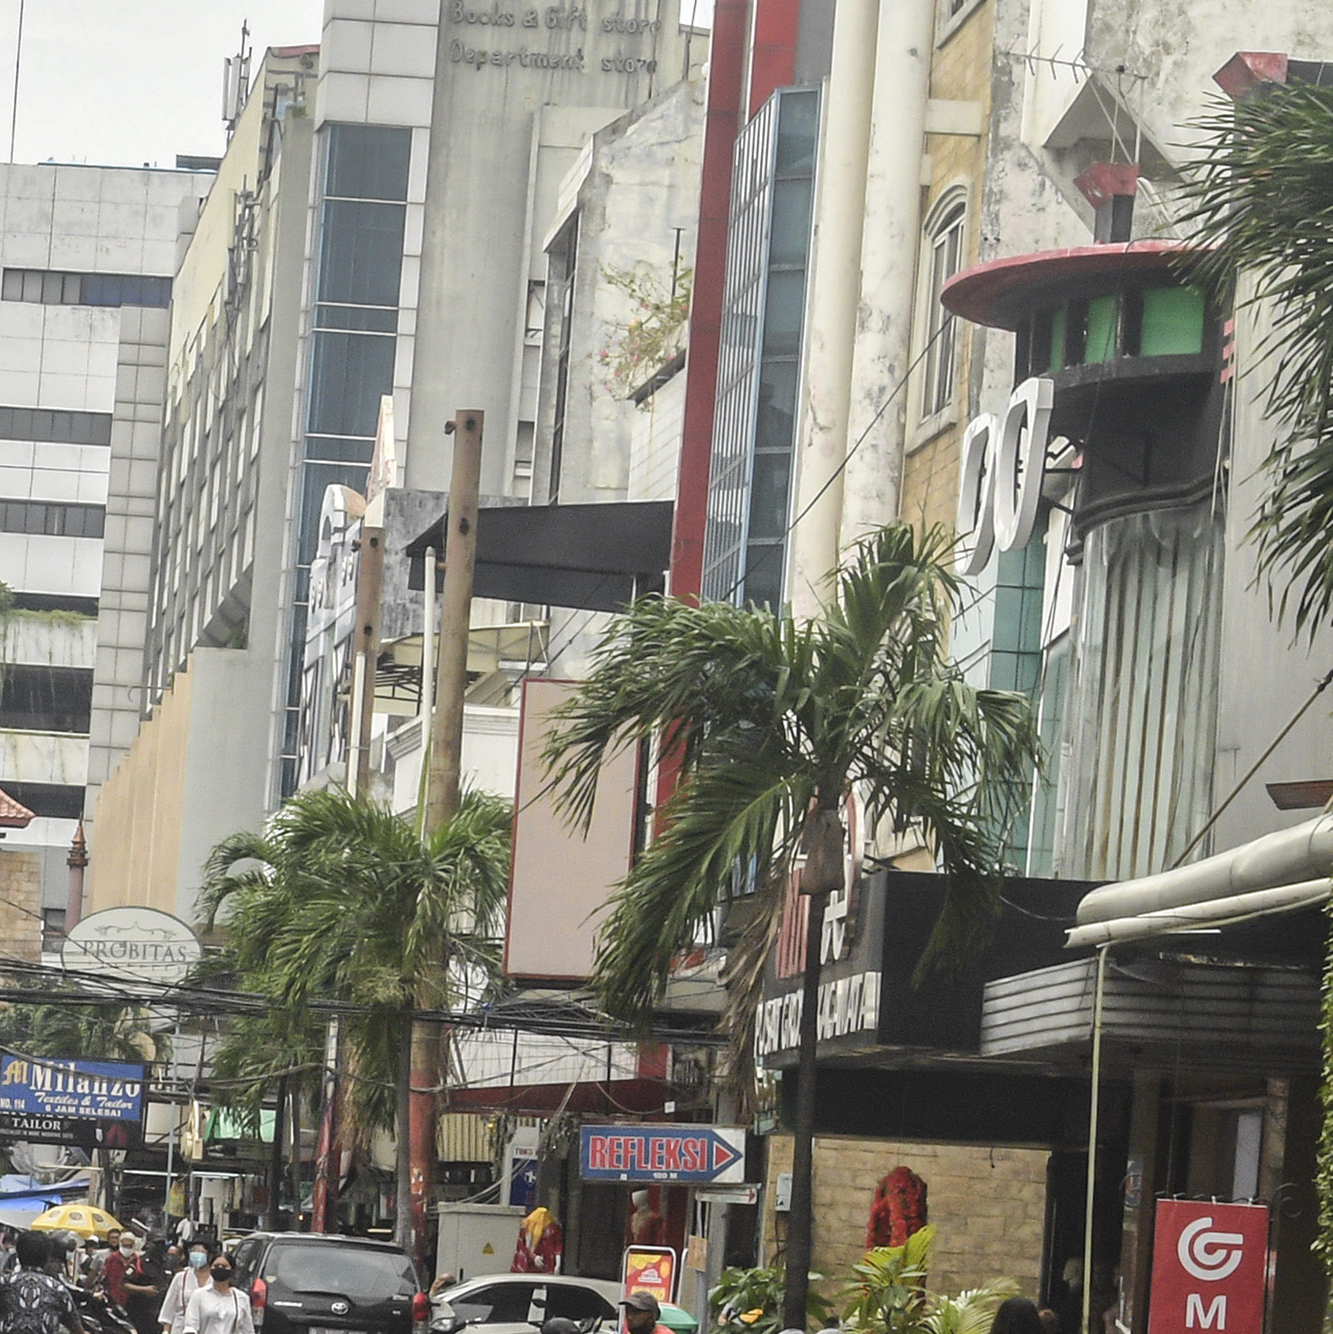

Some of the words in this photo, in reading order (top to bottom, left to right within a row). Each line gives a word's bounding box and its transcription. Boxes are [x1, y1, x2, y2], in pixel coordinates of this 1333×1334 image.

[83, 940, 187, 963] PROBITAS
[12, 1118, 61, 1131] TAILOR
[588, 1135, 708, 1172] REFLEKSI
